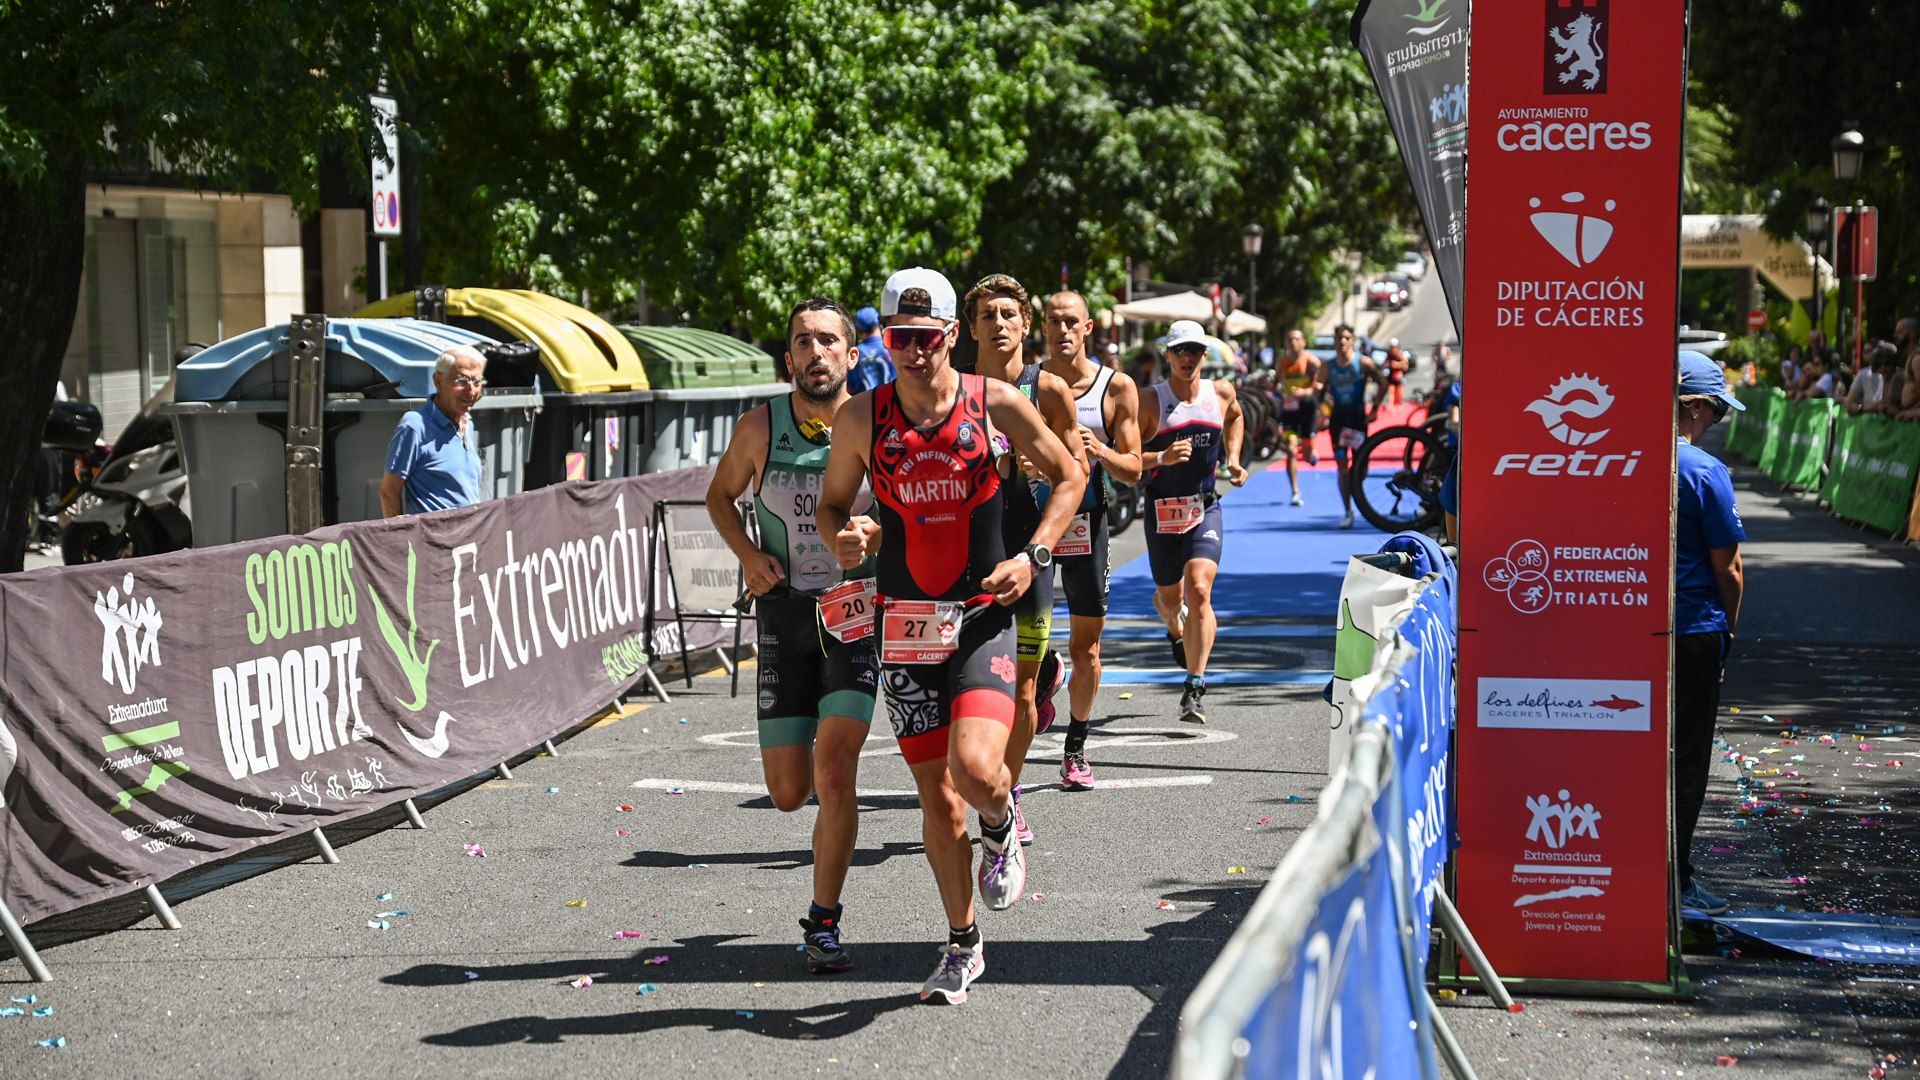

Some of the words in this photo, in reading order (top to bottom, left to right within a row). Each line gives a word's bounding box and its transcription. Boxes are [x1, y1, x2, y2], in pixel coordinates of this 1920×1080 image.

[1497, 107, 1589, 119] AYUNTAMIENTO
[1497, 120, 1652, 151] cáceres
[1498, 276, 1644, 300] DIPUTACIÓN
[1497, 308, 1525, 327] DE
[1534, 303, 1644, 327] CÁCERES
[899, 458, 915, 476] TRI
[915, 450, 963, 473] INFINITY
[767, 469, 799, 492] CEA
[898, 473, 968, 504] MARTÍN
[1169, 508, 1183, 519] 71
[1059, 546, 1085, 554] CÁCERES
[1553, 543, 1649, 561] FEDERACIÓN
[1553, 566, 1648, 584] EXTREMEÑA
[245, 538, 357, 645] SOMOS
[1553, 588, 1648, 606] TRIATLÓN
[841, 598, 865, 619] 20
[904, 620, 928, 638] 27
[107, 696, 169, 725] Extremadura
[212, 636, 374, 780] DEPORTE
[1484, 690, 1512, 708] los
[1516, 688, 1584, 718] delfines
[134, 746, 162, 765] desde
[1523, 850, 1602, 863] Extremadura
[1511, 874, 1547, 885] Deporte
[1549, 875, 1576, 885] desde
[1578, 877, 1587, 885] la
[1589, 876, 1611, 886] Base
[1521, 909, 1560, 919] Dirección
[1562, 911, 1594, 920] General
[1595, 912, 1606, 921] de
[1524, 921, 1556, 932] Jóvenes
[1557, 924, 1562, 932] y
[1564, 921, 1602, 932] Deportes
